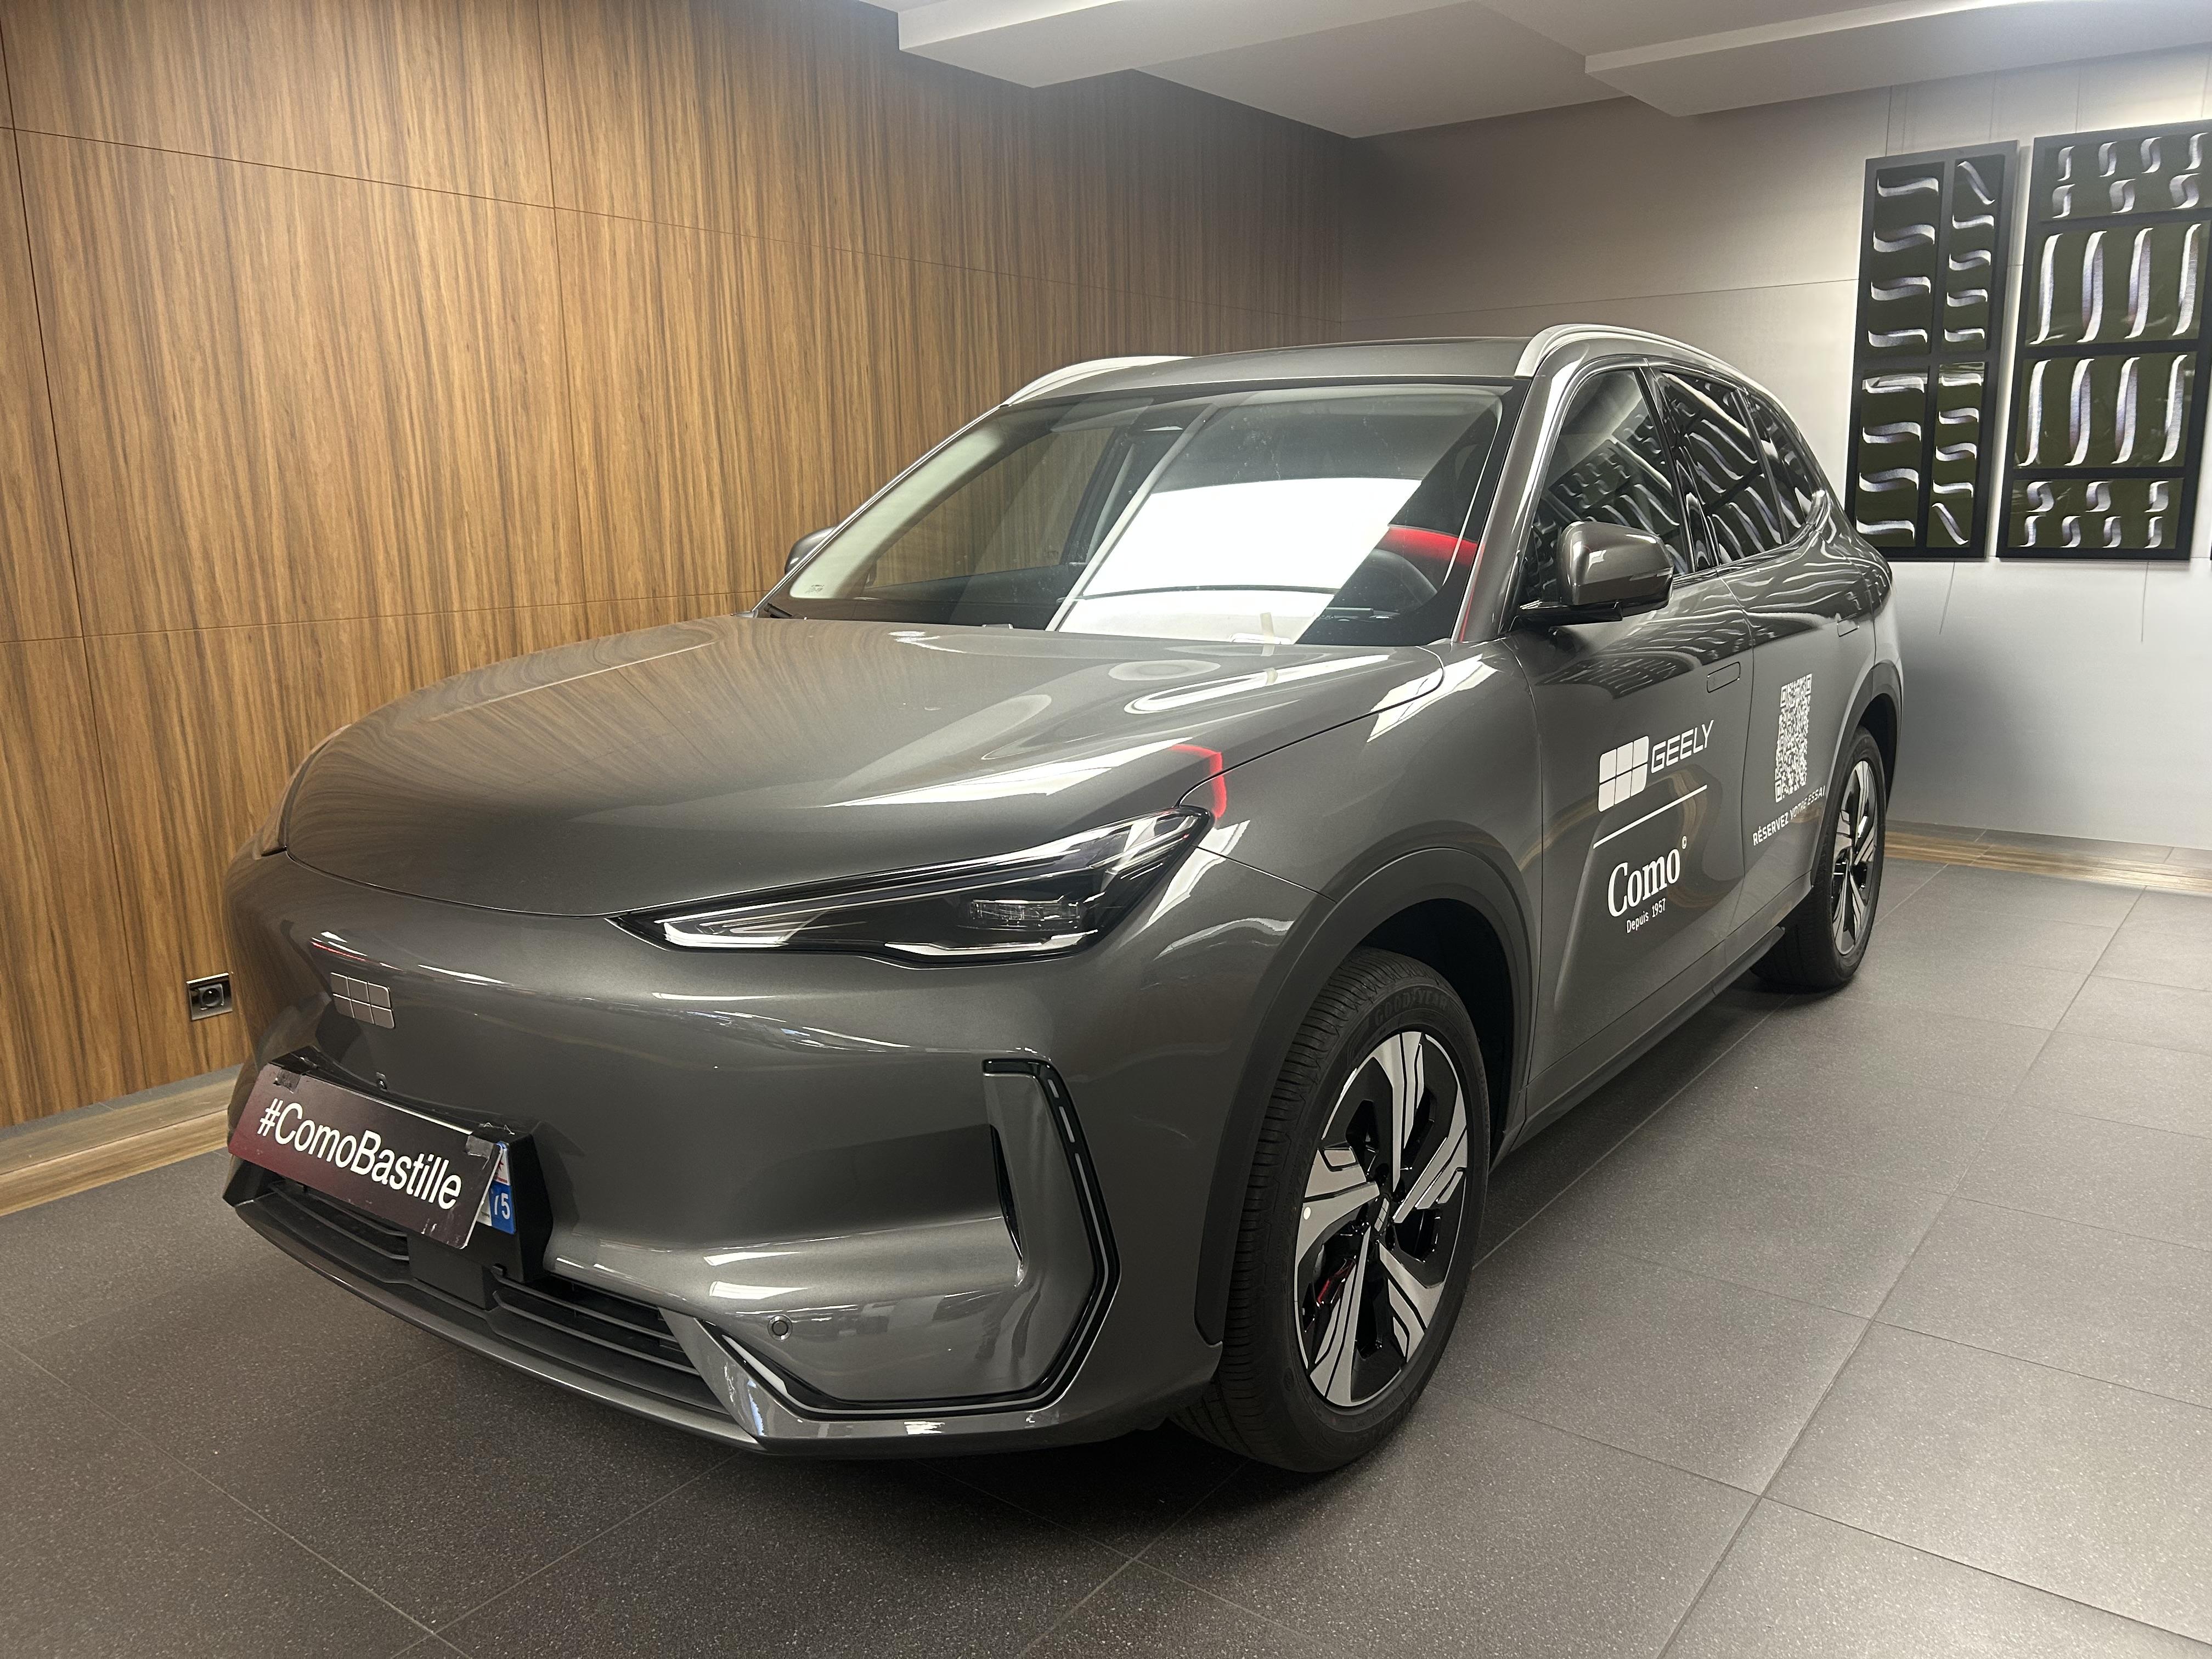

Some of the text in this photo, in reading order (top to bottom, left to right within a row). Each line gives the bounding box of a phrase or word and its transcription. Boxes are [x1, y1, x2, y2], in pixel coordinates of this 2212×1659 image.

[1651, 720, 1714, 774] GEELY
[1752, 785, 1826, 846] RÉSERVEZ VOTRE ESSAI
[1626, 898, 1666, 934] Depuis 1957
[257, 1098, 462, 1210] #ComoBastille
